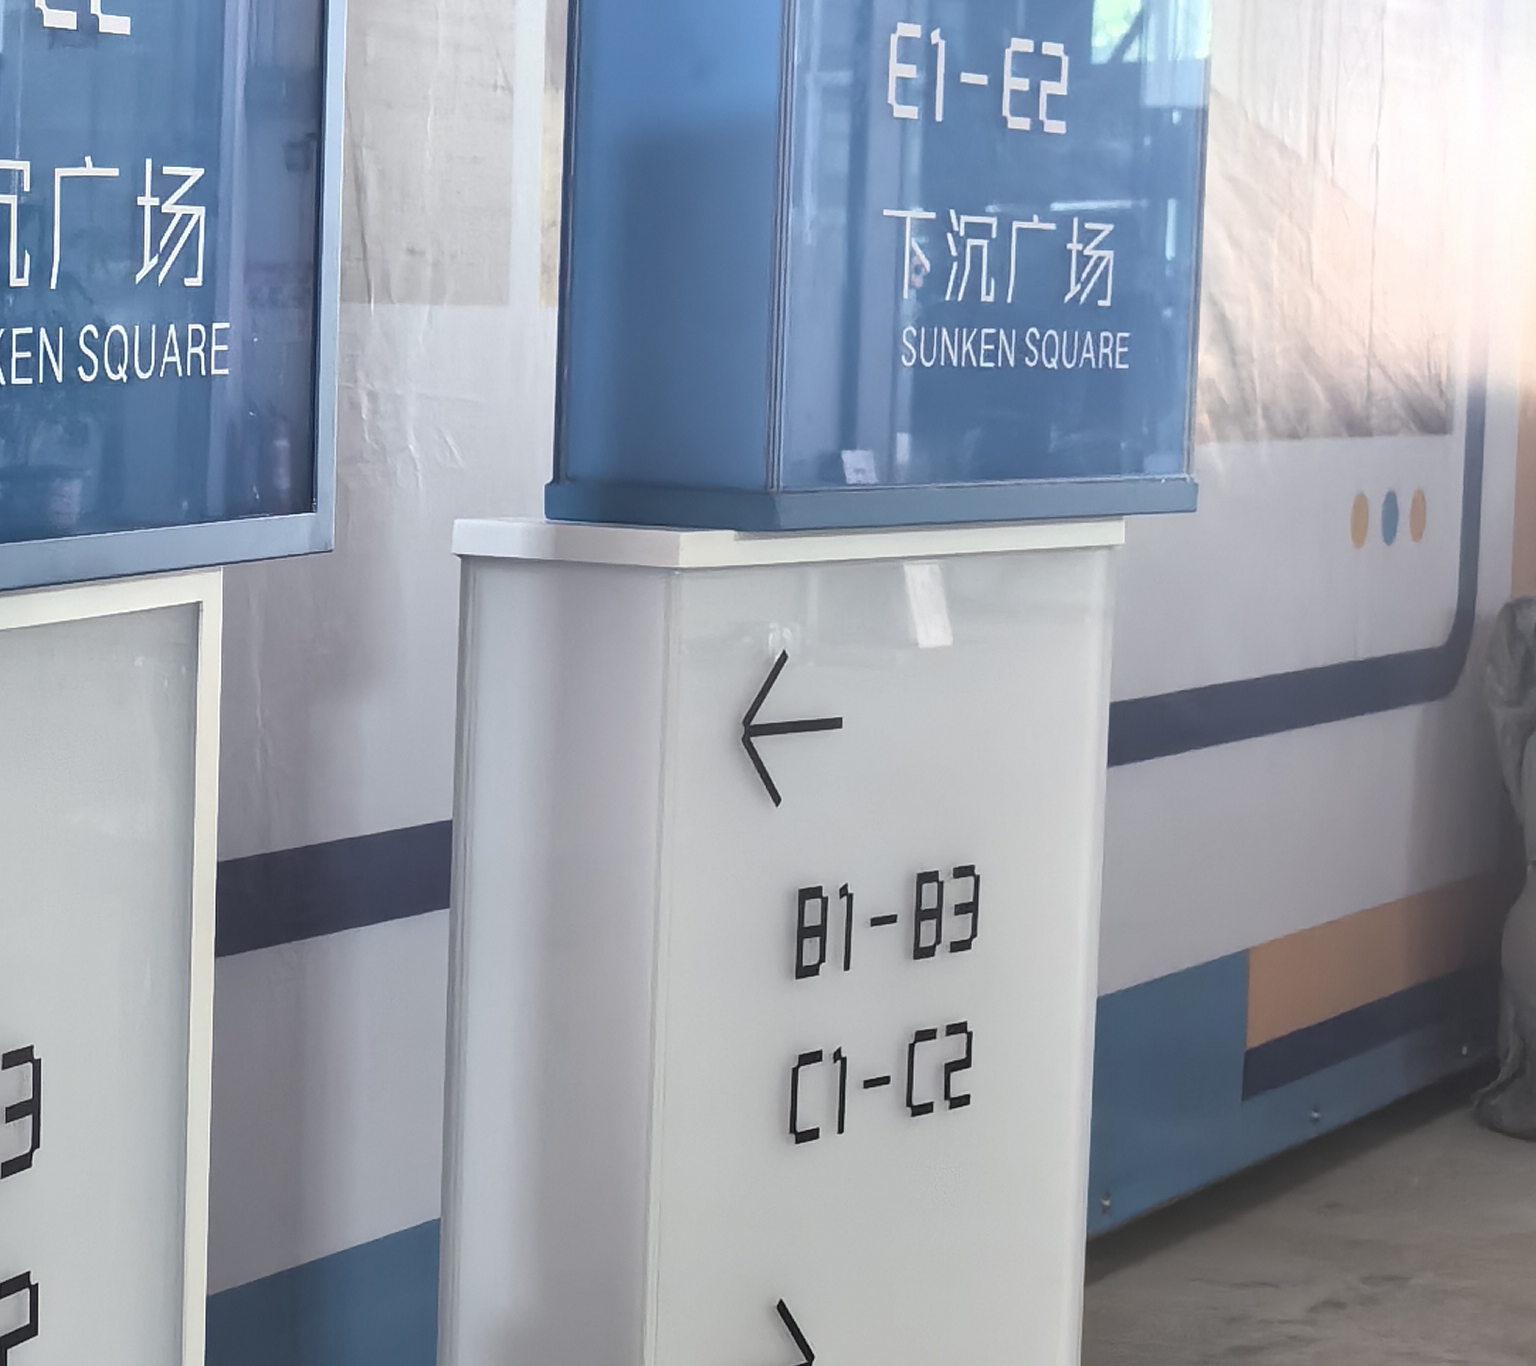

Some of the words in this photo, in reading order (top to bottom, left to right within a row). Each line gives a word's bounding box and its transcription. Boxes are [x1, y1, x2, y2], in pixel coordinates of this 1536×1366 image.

[887, 21, 1069, 134] E1-E2
[882, 209, 1114, 306] 下沉广场
[77, 322, 230, 383] SQUARE
[901, 326, 1015, 367] SUNKEN
[1024, 328, 1130, 369] SQUARE
[795, 865, 980, 979] B1-B3
[789, 1021, 972, 1144] C1-C2
